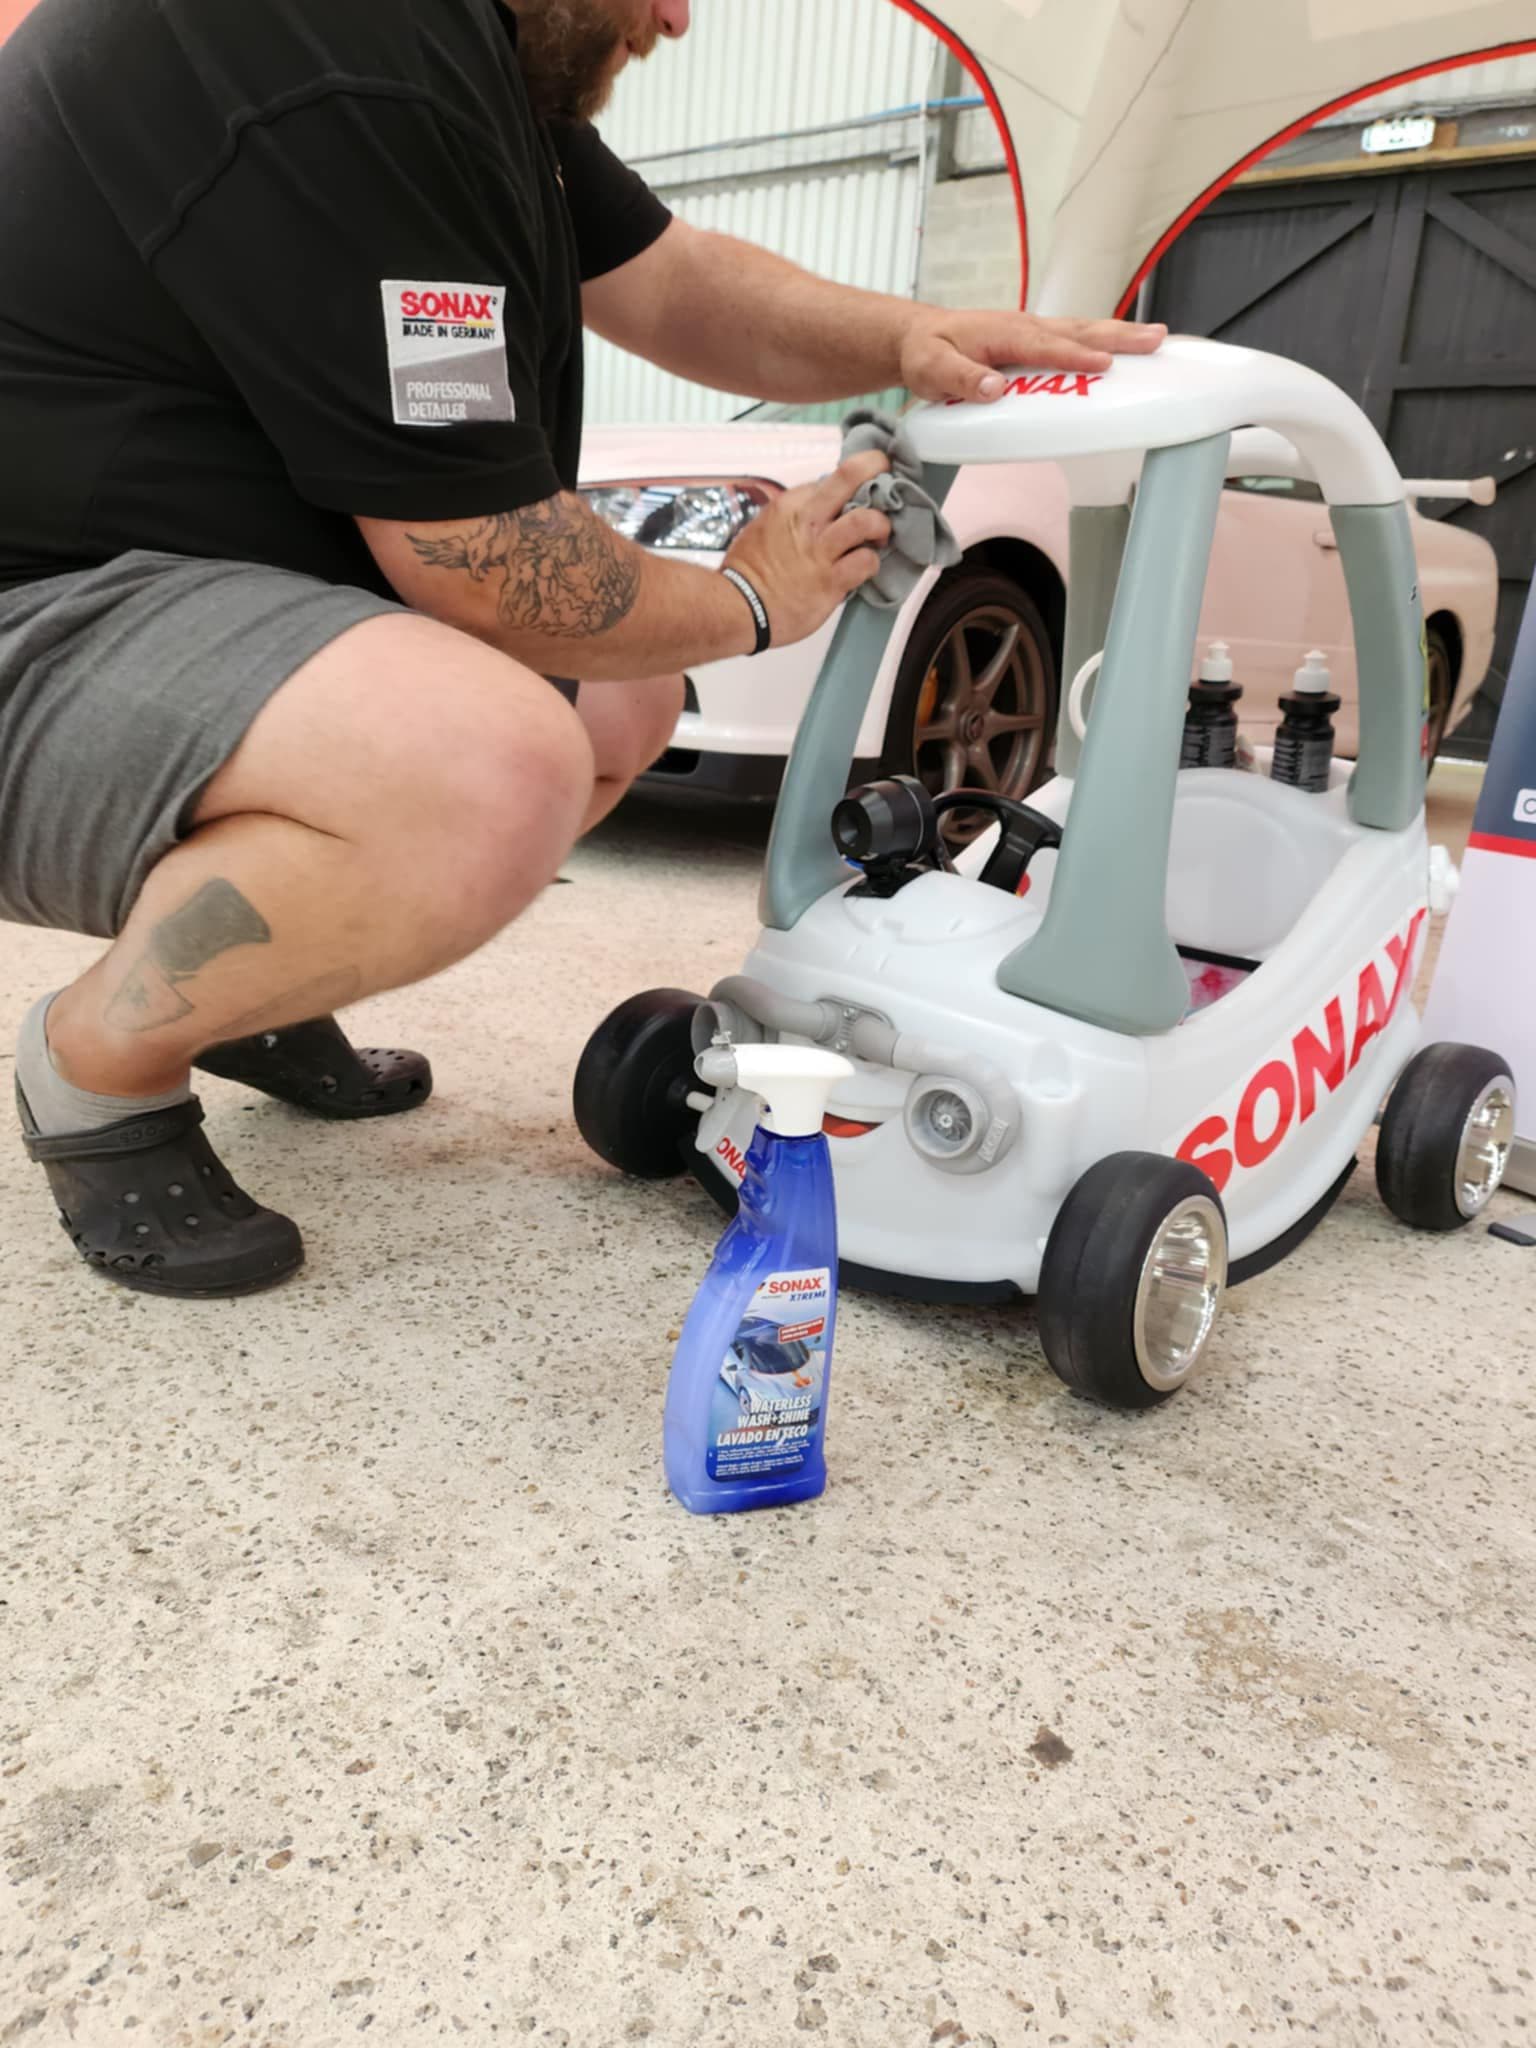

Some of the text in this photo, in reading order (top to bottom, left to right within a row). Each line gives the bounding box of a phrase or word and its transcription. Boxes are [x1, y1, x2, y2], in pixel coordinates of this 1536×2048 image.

[401, 291, 493, 319] SONAX
[403, 324, 496, 339] MADE IN GERMANY
[407, 382, 492, 400] PROFESSIONAL
[409, 402, 468, 419] DETAILER
[1175, 907, 1426, 1193] SONAX
[716, 1137, 747, 1180] ONA
[769, 1278, 823, 1294] SONAX
[790, 1290, 827, 1302] XTREME
[750, 1395, 812, 1413] WATERLESS
[717, 1425, 808, 1448] LAVADO EN SECO
